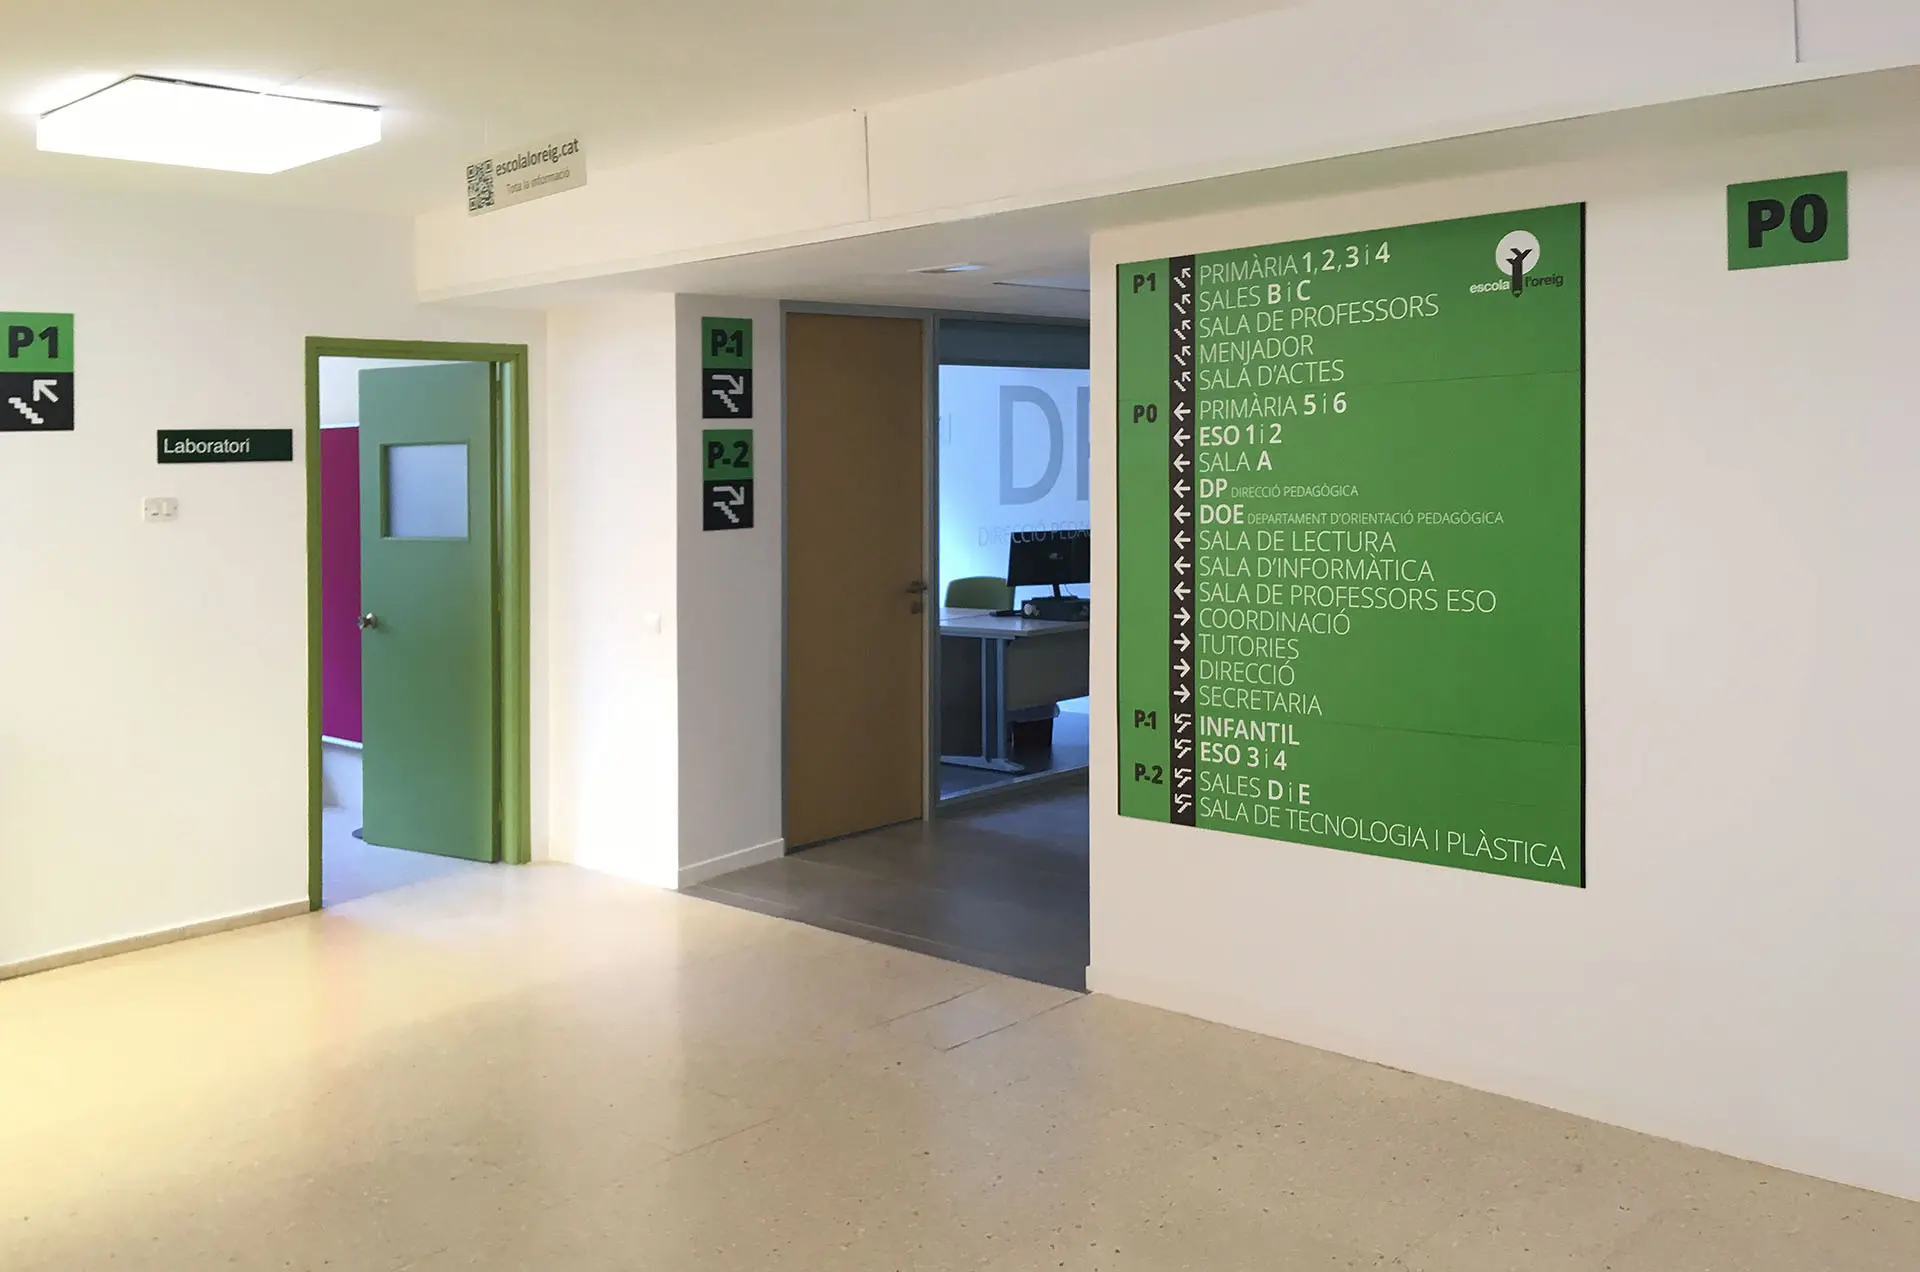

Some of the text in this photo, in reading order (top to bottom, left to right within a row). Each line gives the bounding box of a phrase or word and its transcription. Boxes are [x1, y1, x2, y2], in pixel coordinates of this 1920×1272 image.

[495, 138, 580, 176] escolaloreig.cat
[1748, 193, 1829, 249] P0
[1200, 253, 1298, 285] PRIMÀRIA
[1365, 244, 1369, 265] i
[1375, 241, 1390, 263] 4
[1133, 273, 1156, 293] P1
[1200, 280, 1311, 312] SALES B i C
[1469, 274, 1564, 293] escola l'oreig
[1200, 293, 1440, 338] SALA DE PROFESSORS
[8, 325, 59, 358] P1
[711, 329, 743, 357] P-1
[1200, 335, 1314, 365] MENJADOR
[1200, 359, 1345, 390] SALA D'ACTES
[1133, 404, 1157, 423] P0
[1200, 392, 1347, 420] PRIMÀRIA 5 i 6
[163, 437, 250, 454] Laboratori
[1000, 385, 1090, 505] D
[1200, 423, 1282, 446] ESO 1 i 2
[707, 441, 749, 468] P-2
[1200, 450, 1272, 472] SALA A
[1200, 478, 1359, 498] DP DIRECCIÓ PEDAGÒGICA
[1200, 504, 1504, 525] DOE DEPARTAMENT D'ORIENTACIÓ PEDAGÒGICA
[1051, 520, 1090, 541] PEDA
[1200, 530, 1396, 552] SALA DE LECTURA
[1200, 553, 1434, 582] SALA D'INFORMÀTICA
[1200, 582, 1496, 613] SALA DE PROFESSORS ESO
[1200, 607, 1350, 635] COORDINACIÓ
[1199, 633, 1299, 660] TUTORIES
[1200, 659, 1295, 686] DIRECCIÓ
[1200, 685, 1322, 716] SECRETARIA
[1134, 709, 1156, 730] P-1
[1200, 716, 1299, 746] INFANTIL
[1200, 742, 1287, 771] ESO 3 i 4
[1134, 763, 1163, 784] P-2
[1200, 771, 1310, 804] SALES D i E
[1200, 796, 1566, 870] SALA DE TECNOLOGIA I PLÀSTICA
